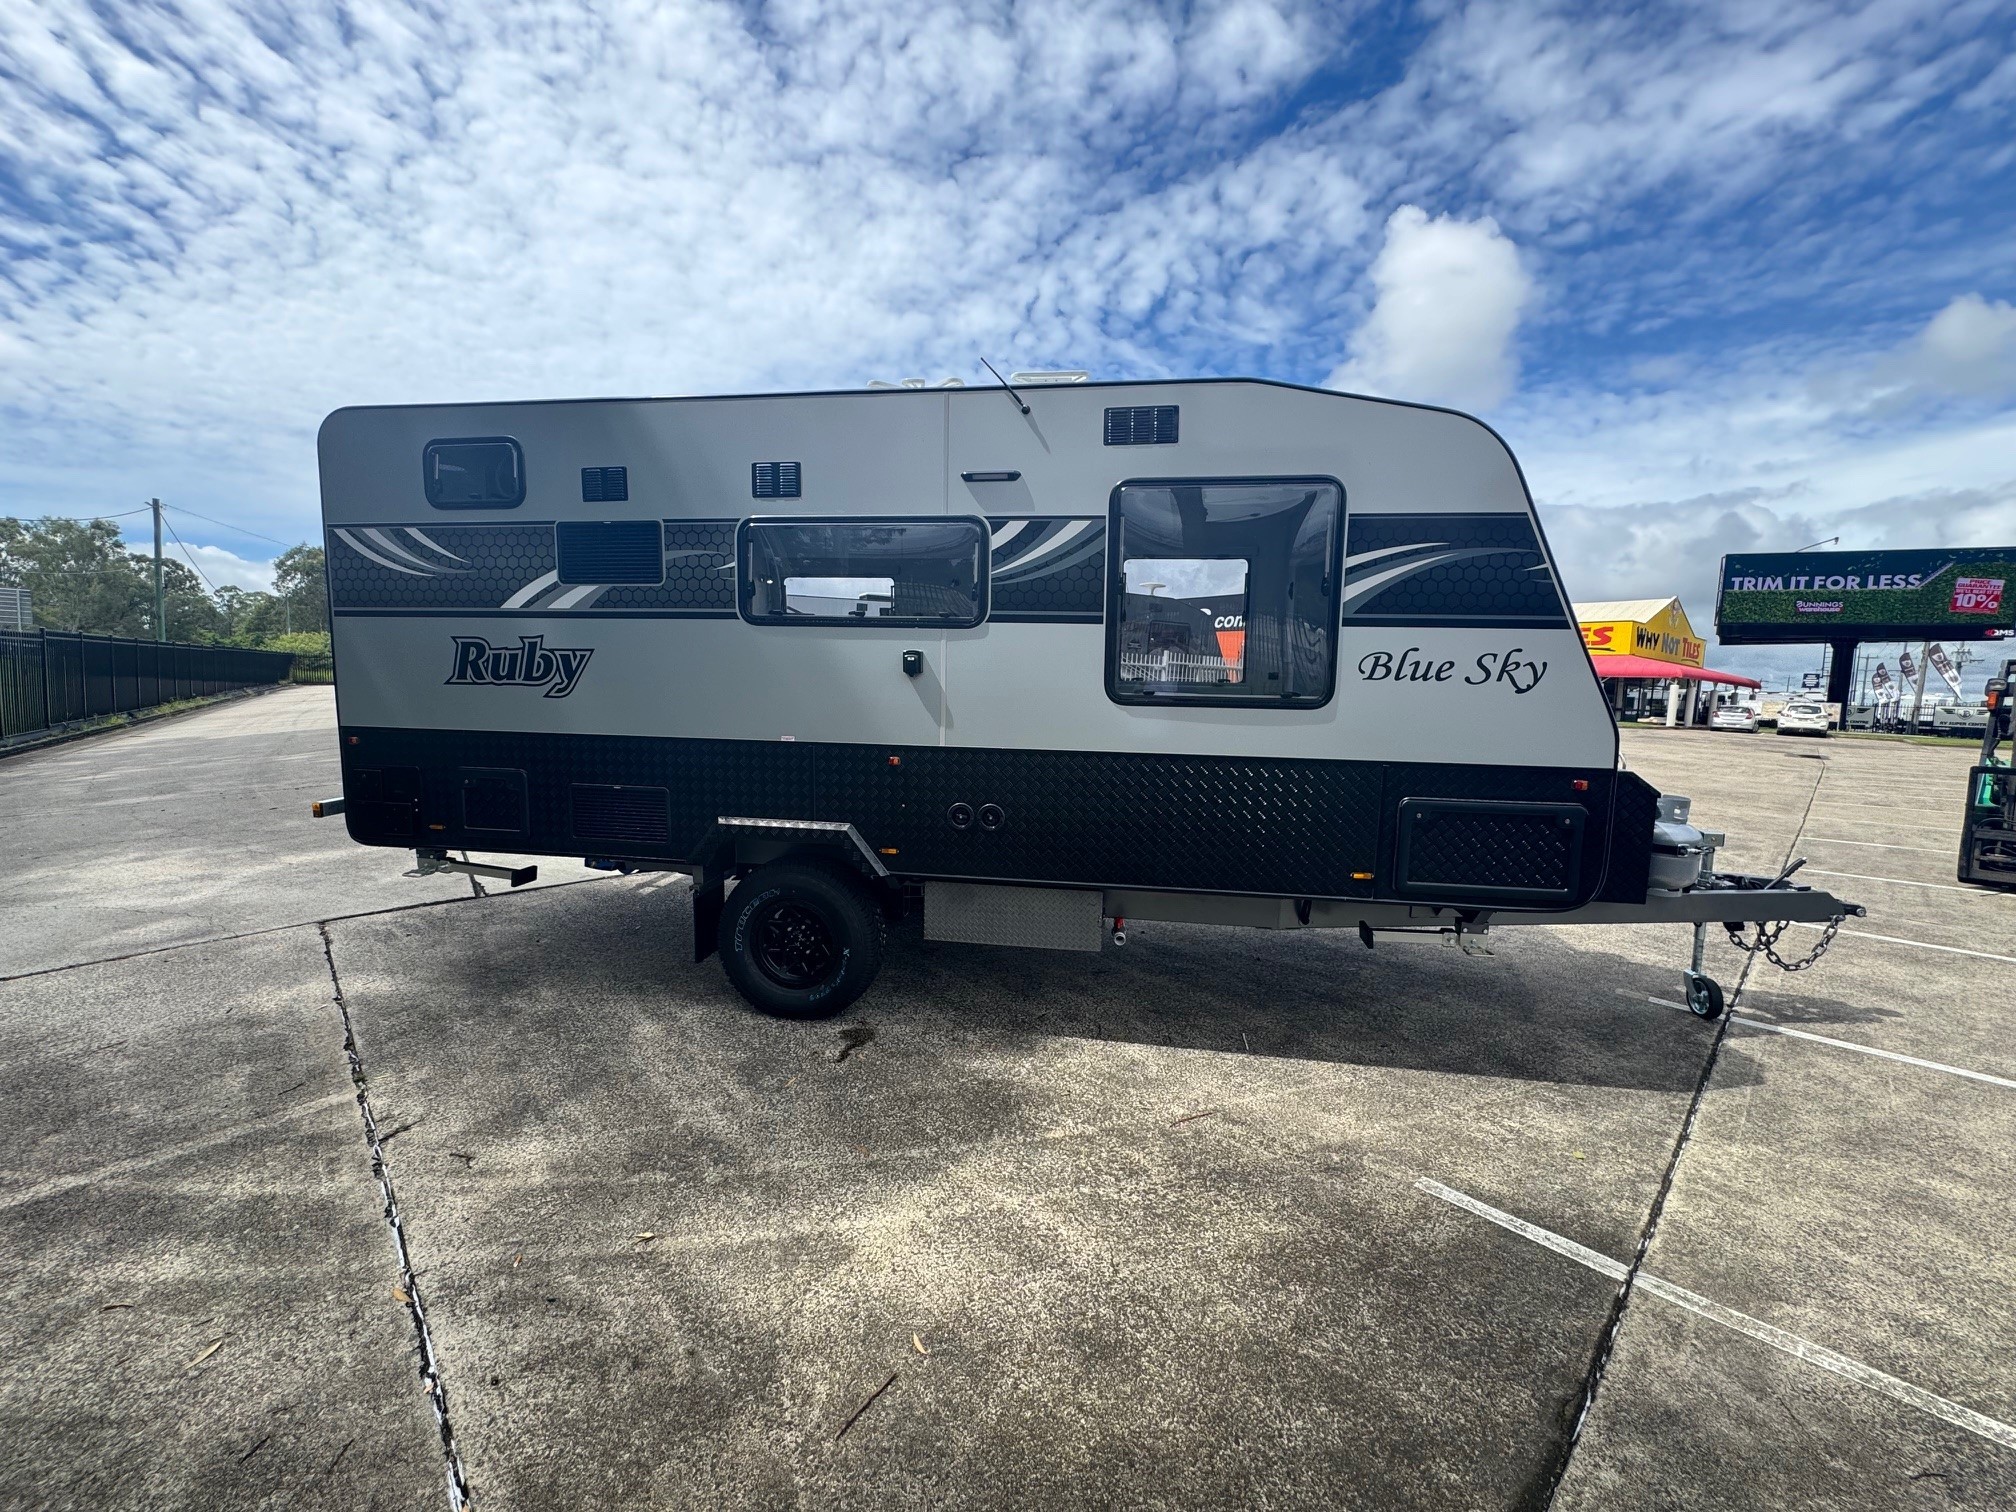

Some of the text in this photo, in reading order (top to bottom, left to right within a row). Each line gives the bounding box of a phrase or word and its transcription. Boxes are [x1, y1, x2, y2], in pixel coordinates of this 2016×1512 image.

[1731, 574, 1922, 591] TRIM IT FOR LESS
[1796, 600, 1844, 608] BUNNINGS
[1953, 593, 1998, 609] 10%
[1636, 625, 1701, 660] WHY NOT TILES
[443, 634, 595, 698] Ruby
[1358, 647, 1548, 694] Blue Sky
